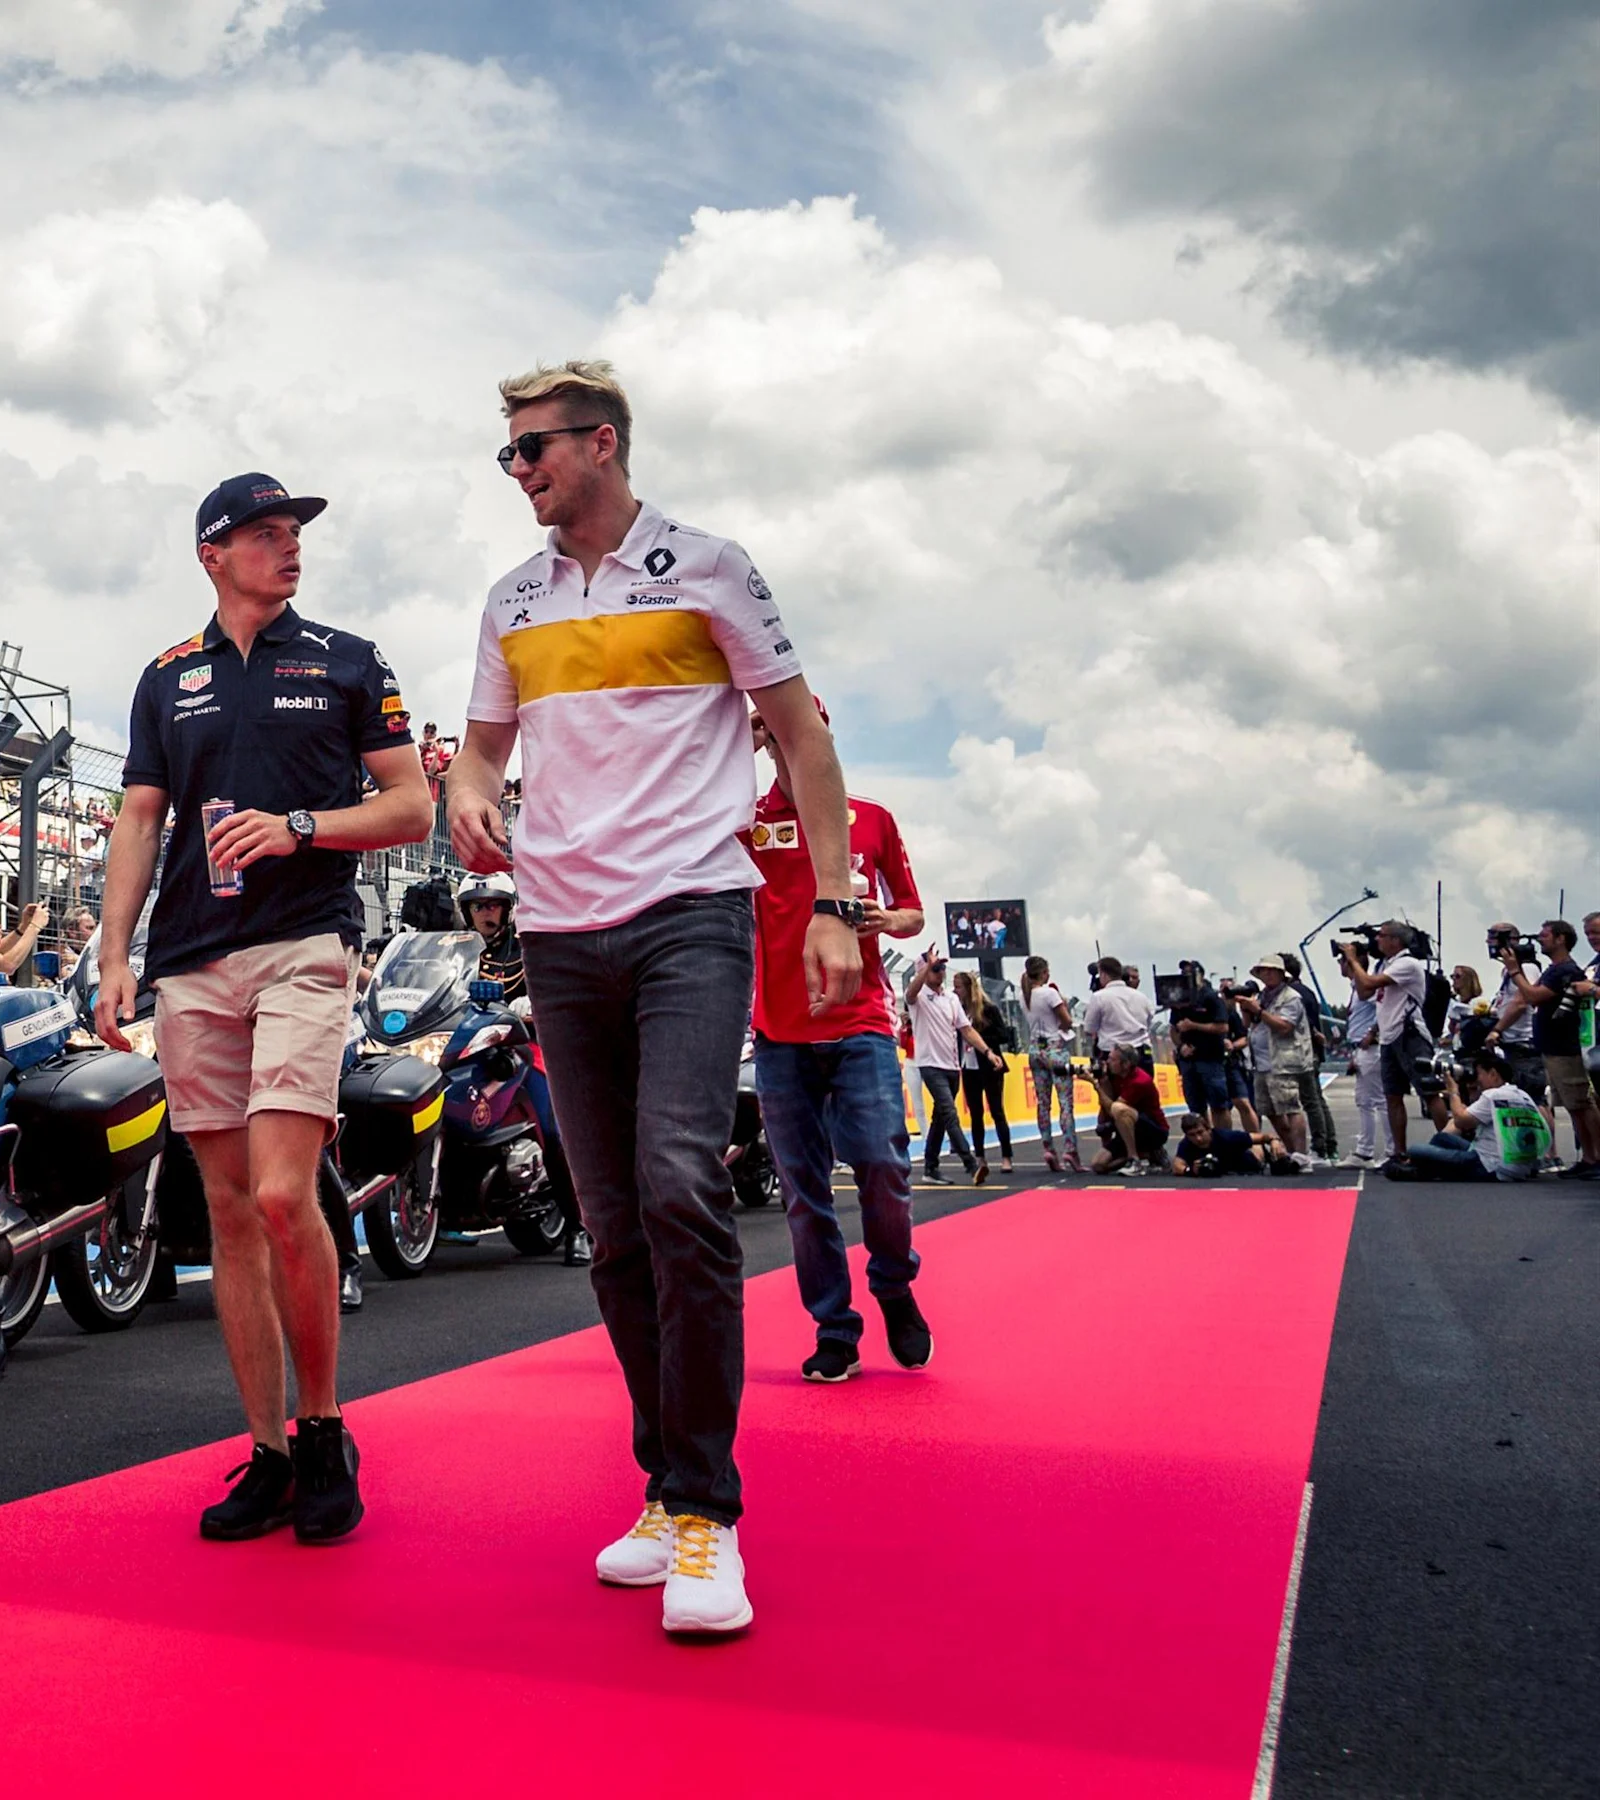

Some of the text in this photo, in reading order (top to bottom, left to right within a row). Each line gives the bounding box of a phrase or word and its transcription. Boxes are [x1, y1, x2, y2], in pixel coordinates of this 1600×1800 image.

[500, 590, 554, 607] INFINITI
[639, 595, 678, 605] Castrol
[274, 697, 312, 709] Mobil
[22, 1010, 68, 1036] GENDARMERIE
